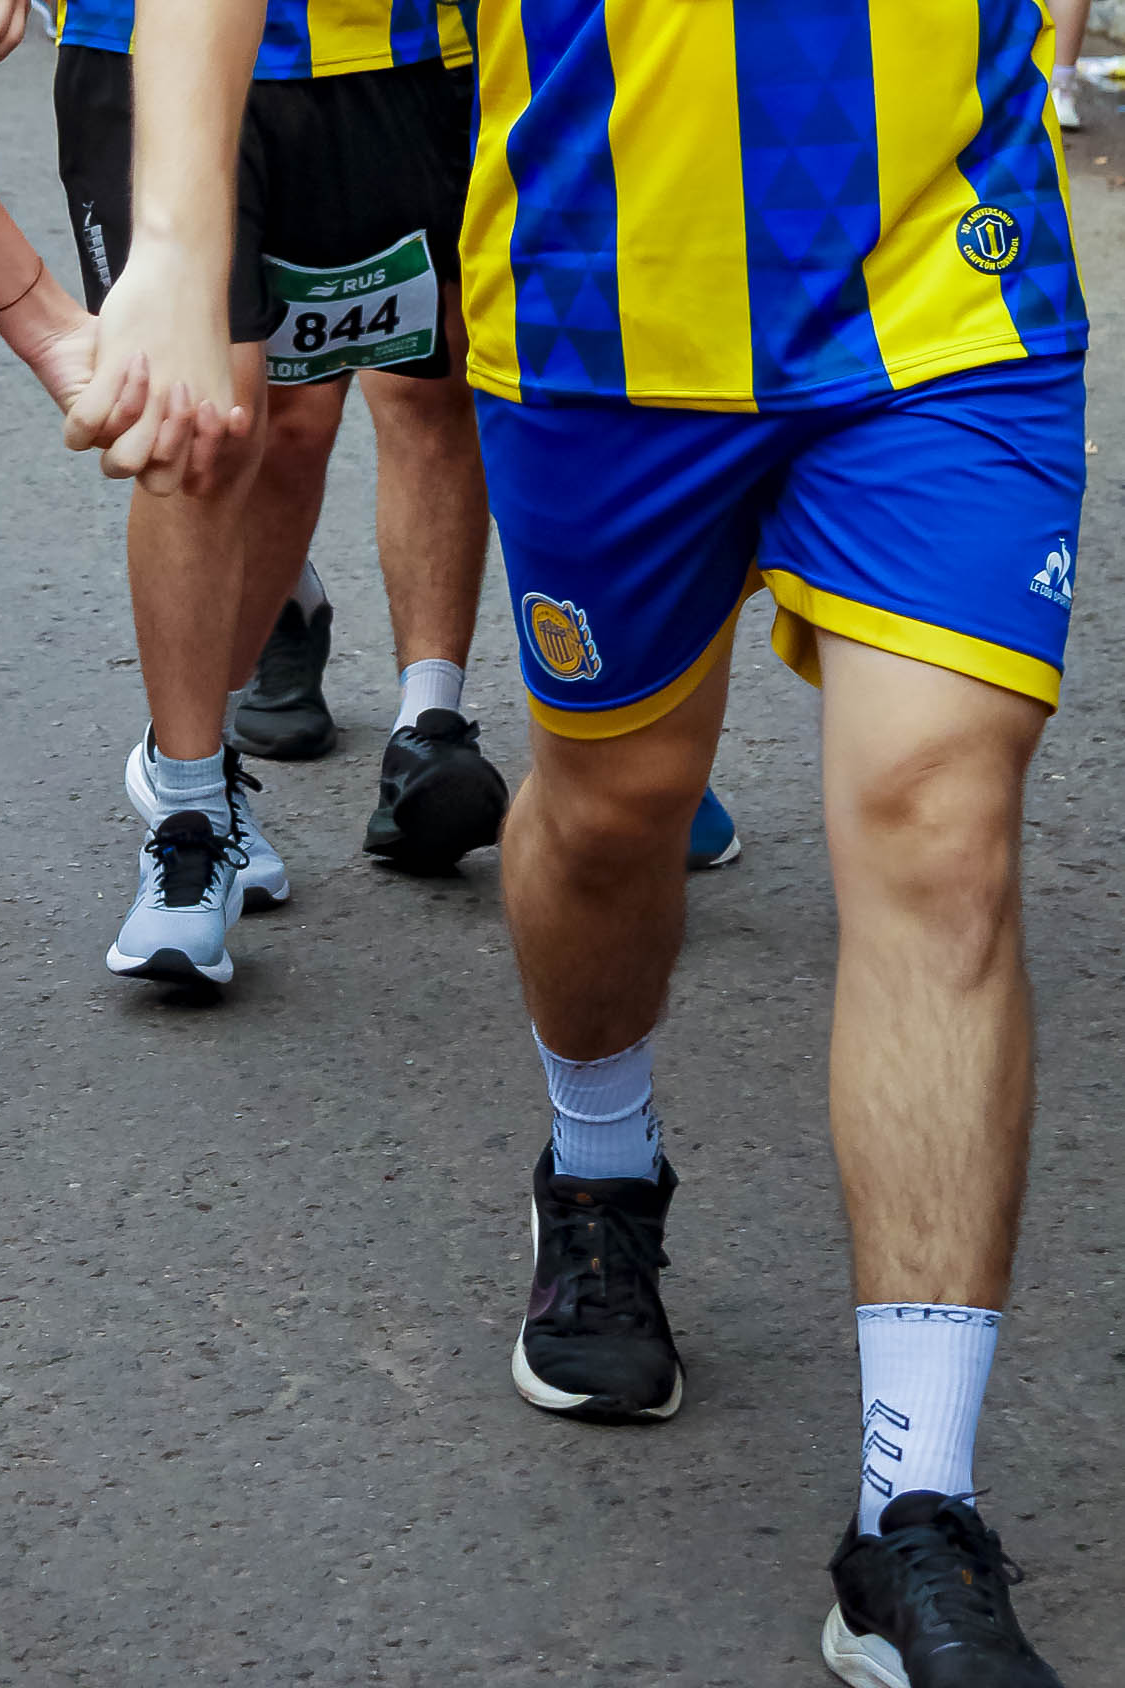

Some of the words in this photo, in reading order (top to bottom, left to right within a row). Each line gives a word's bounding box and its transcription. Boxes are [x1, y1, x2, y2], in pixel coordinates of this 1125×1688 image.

[342, 269, 386, 294] RUS
[292, 293, 400, 353] 844
[267, 362, 309, 377] 10K
